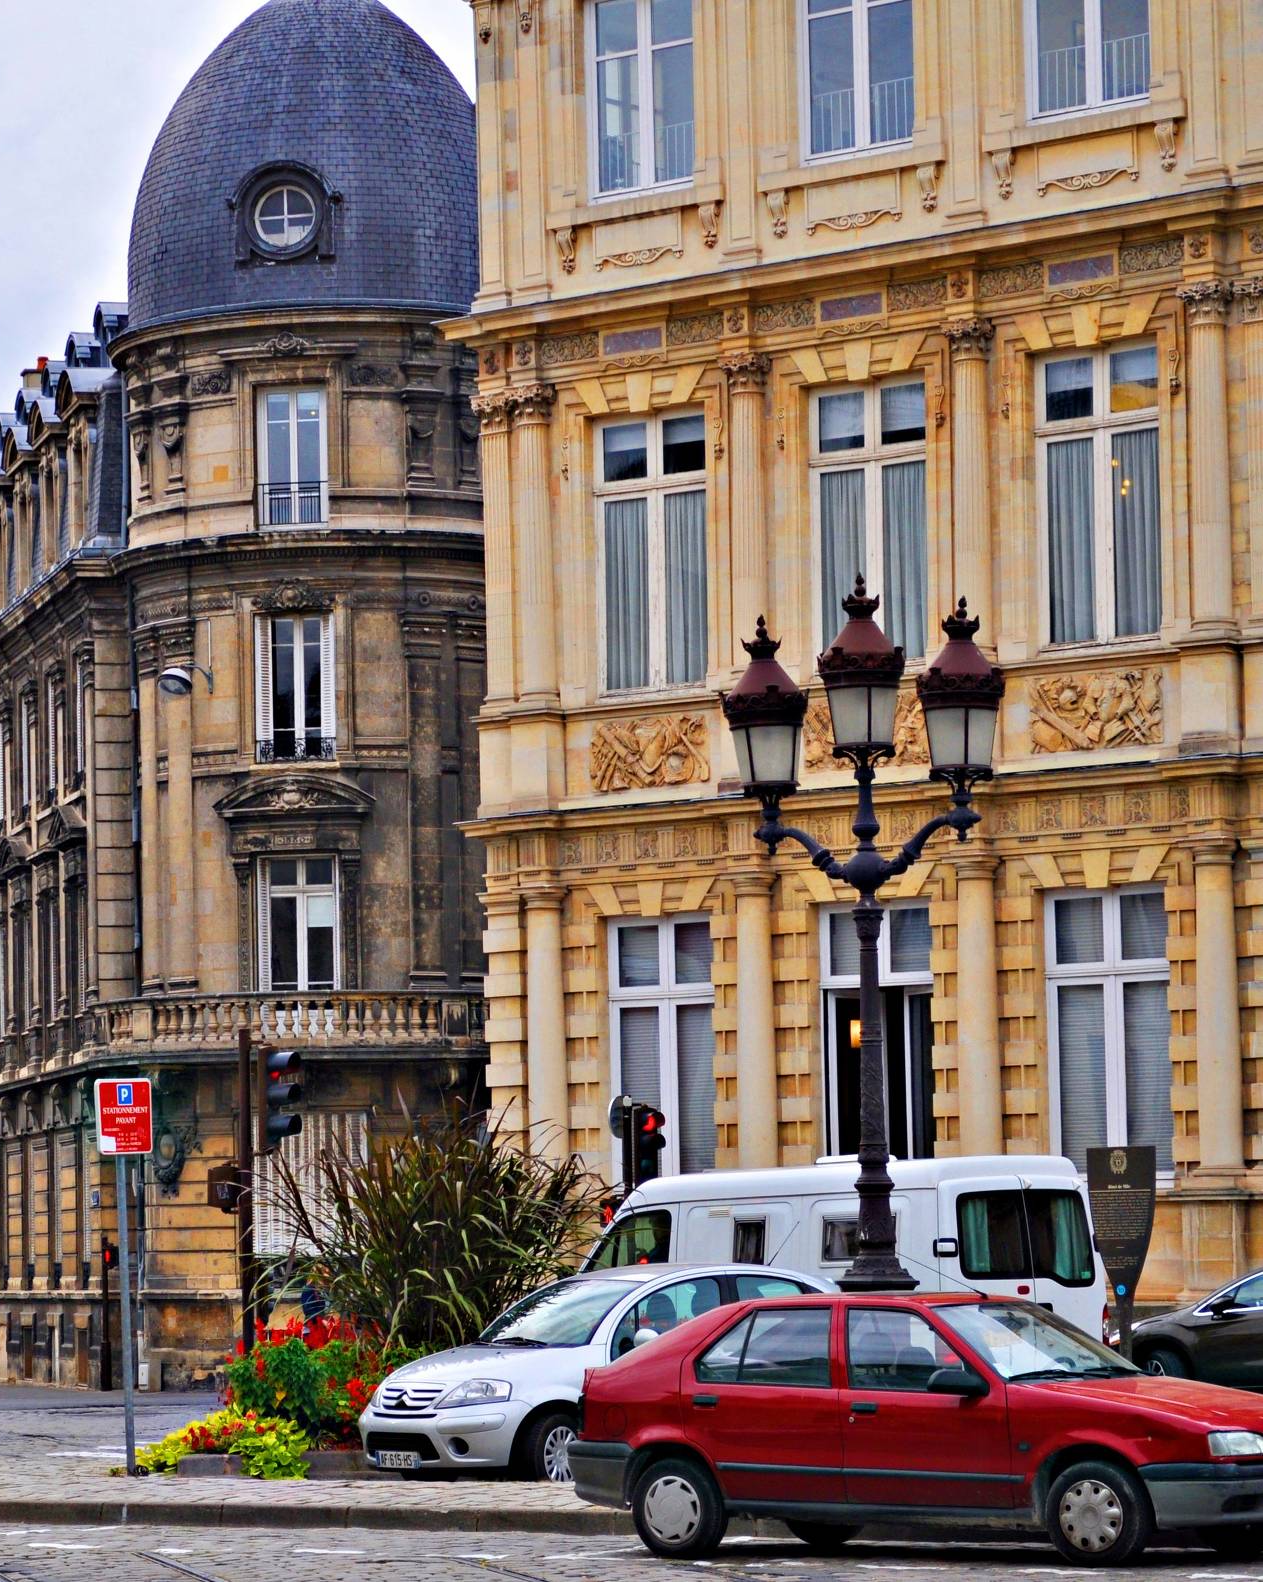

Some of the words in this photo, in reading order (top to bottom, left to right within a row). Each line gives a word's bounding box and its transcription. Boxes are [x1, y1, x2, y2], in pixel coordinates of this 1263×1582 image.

[120, 1088, 129, 1102] P
[102, 1106, 148, 1115] STATIONNEMENT
[116, 1116, 136, 1124] PAYANT
